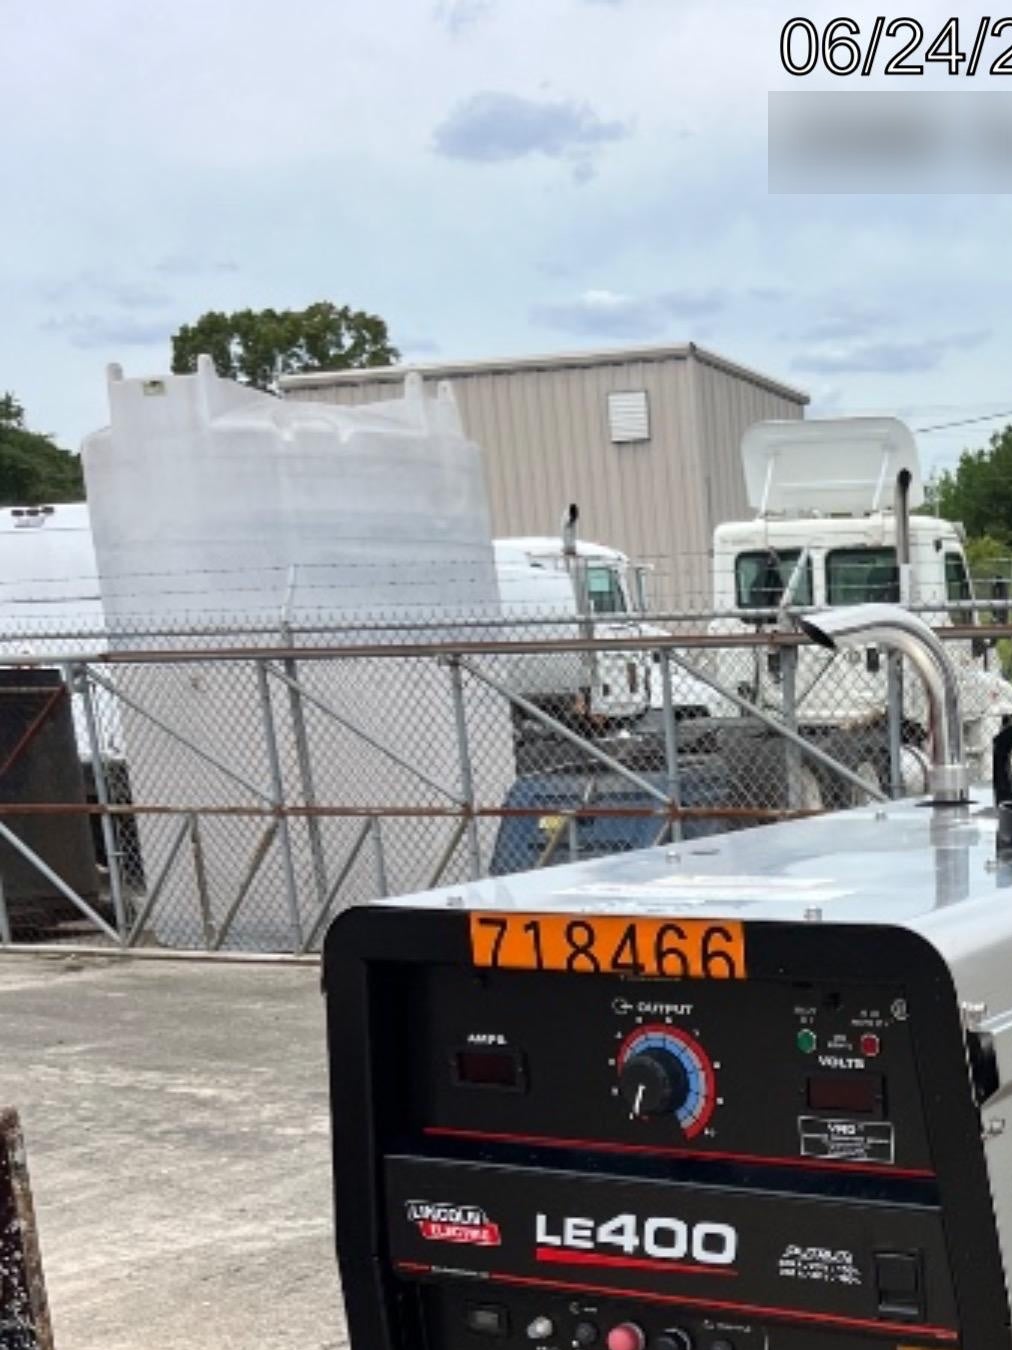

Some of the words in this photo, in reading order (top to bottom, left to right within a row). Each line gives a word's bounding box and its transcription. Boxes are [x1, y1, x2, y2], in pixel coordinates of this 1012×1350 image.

[478, 917, 736, 978] 718466
[637, 1001, 694, 1016] OUTPUT
[818, 1054, 866, 1069] VOLTS
[535, 1212, 738, 1265] LE400
